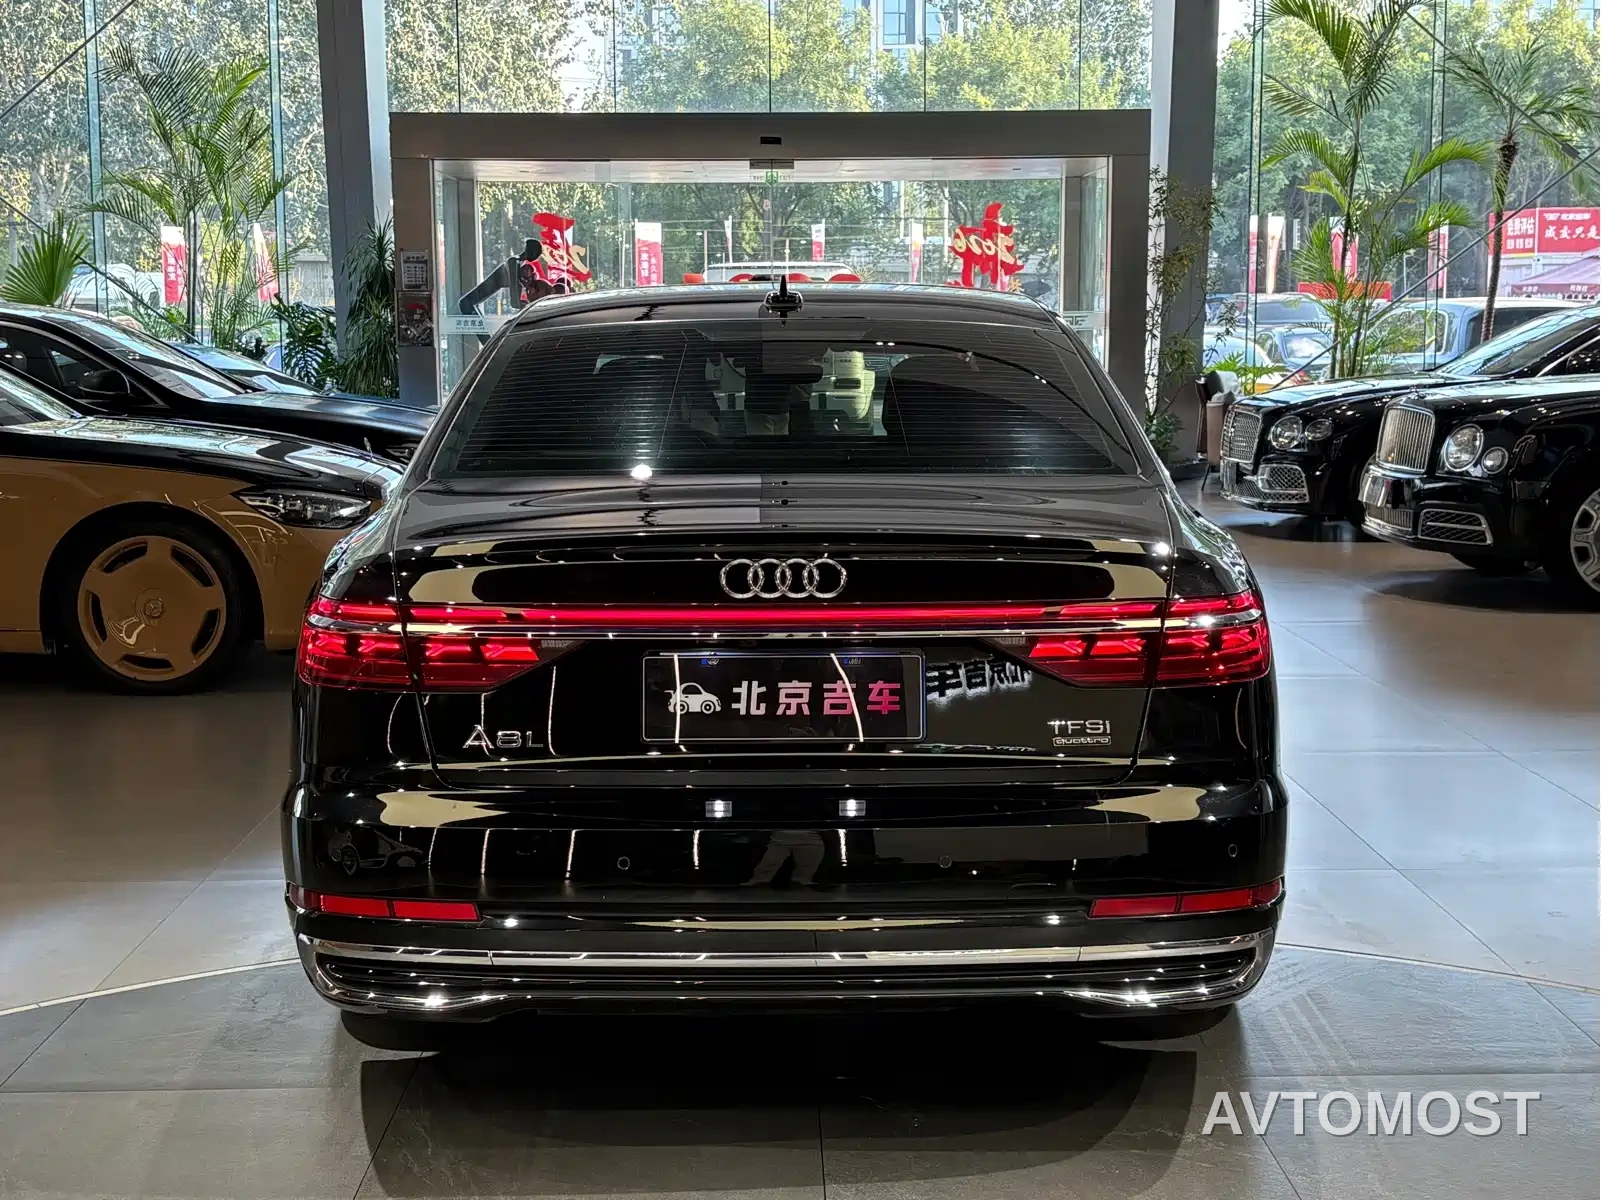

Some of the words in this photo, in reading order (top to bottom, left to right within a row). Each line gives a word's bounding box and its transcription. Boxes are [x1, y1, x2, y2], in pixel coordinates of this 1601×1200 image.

[731, 680, 901, 716] 北京吉车
[462, 724, 544, 749] A8L
[1055, 736, 1110, 745] quattro
